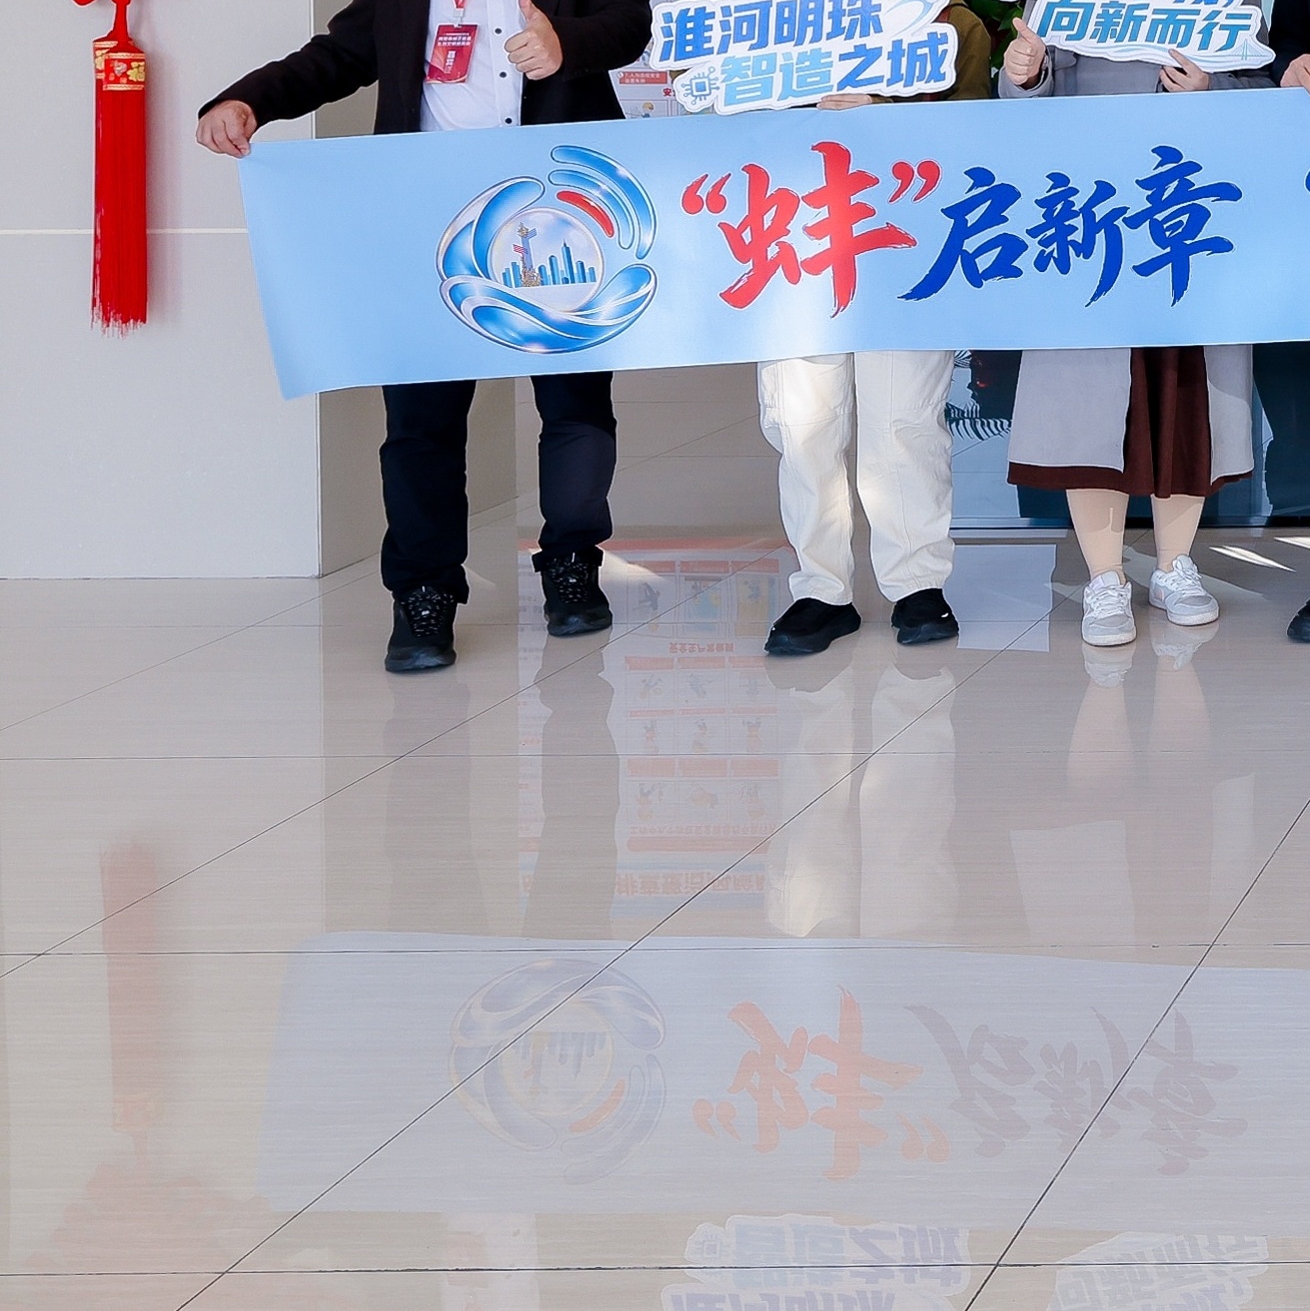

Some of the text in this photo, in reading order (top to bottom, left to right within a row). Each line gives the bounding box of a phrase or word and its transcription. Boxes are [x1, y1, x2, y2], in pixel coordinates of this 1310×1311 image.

[720, 31, 949, 106] 智造之城
[681, 140, 1244, 319] “蚌”启新章
